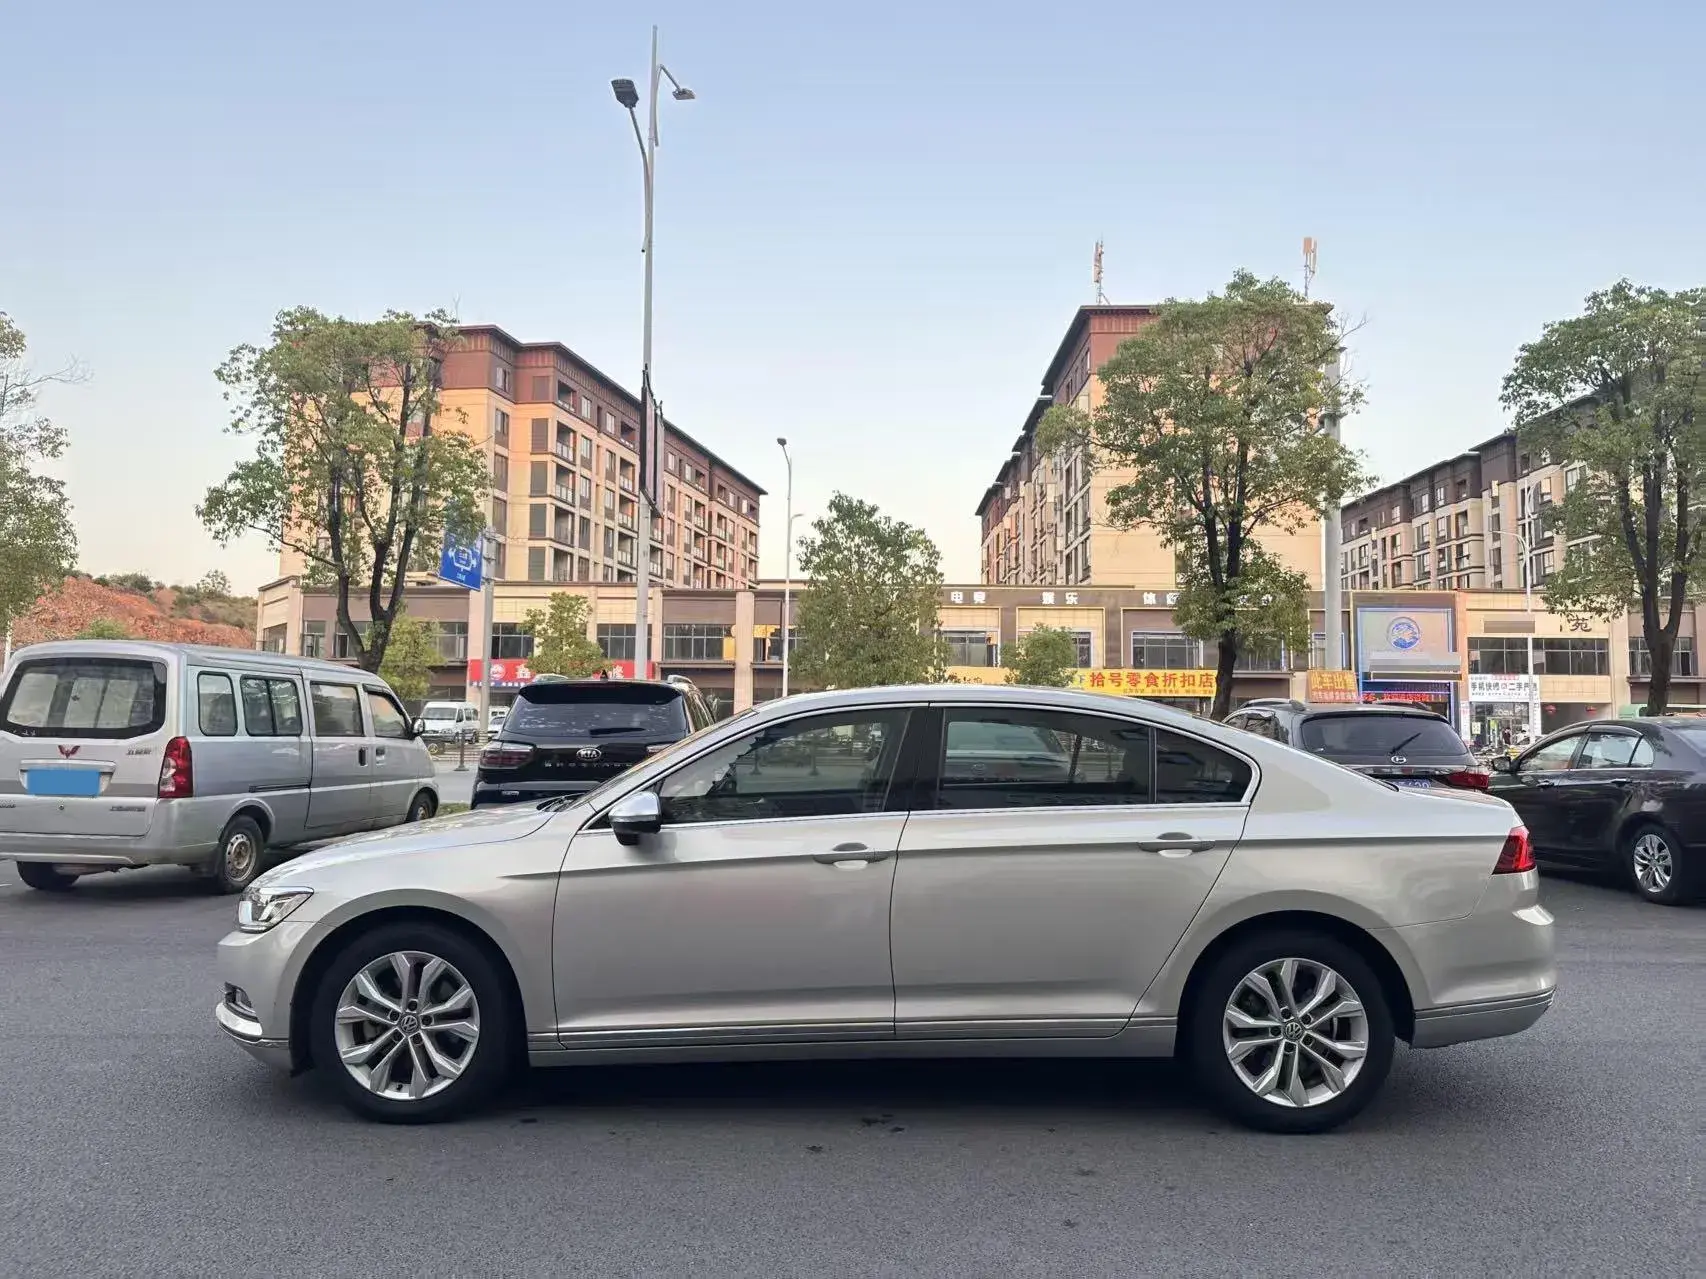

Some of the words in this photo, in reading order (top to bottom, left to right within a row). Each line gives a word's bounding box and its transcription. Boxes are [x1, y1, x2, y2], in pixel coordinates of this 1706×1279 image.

[1089, 671, 1215, 688] 拾号零食折扣店
